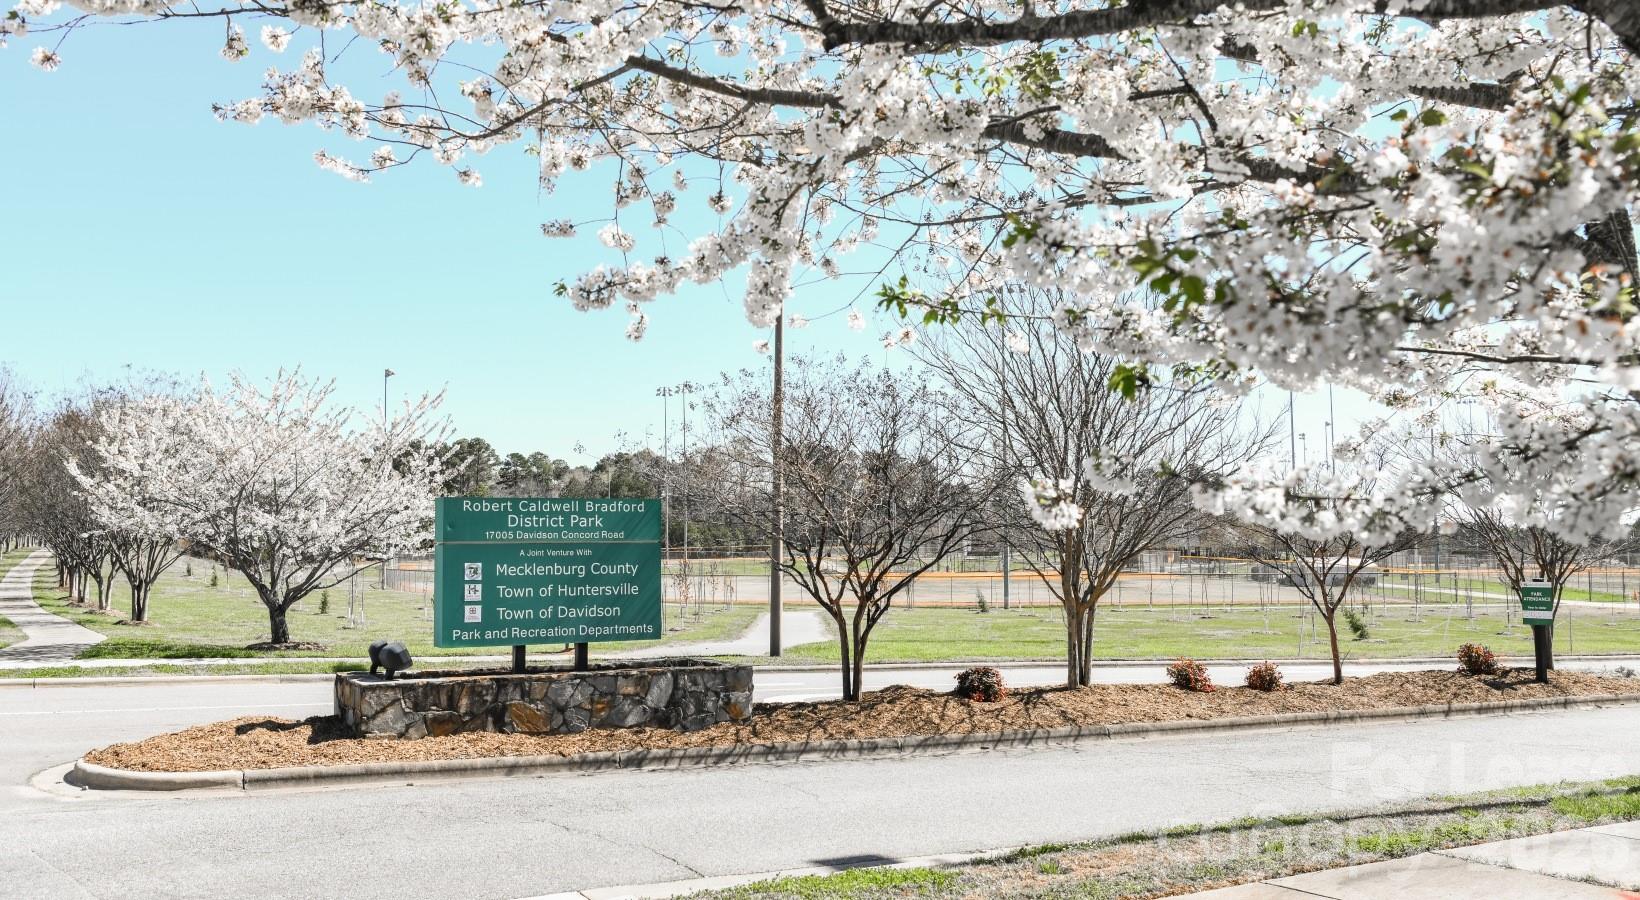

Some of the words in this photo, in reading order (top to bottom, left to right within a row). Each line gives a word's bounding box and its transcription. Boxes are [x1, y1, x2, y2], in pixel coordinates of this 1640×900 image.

[463, 500, 512, 512] Robert
[518, 501, 579, 512] Caldwell
[585, 501, 645, 512] Bradford
[508, 515, 564, 527] District
[570, 515, 603, 527] Park
[496, 564, 585, 577] Mecklenburg
[591, 563, 639, 577] County
[497, 585, 534, 598] Town
[539, 585, 553, 597] of
[558, 584, 639, 596] Huntersville
[497, 607, 534, 620] Town
[539, 606, 553, 618] of
[558, 606, 621, 618] Davidson
[453, 629, 481, 640] Park
[485, 628, 508, 639] and
[512, 626, 576, 638] Recreation
[579, 624, 653, 637] Departments
